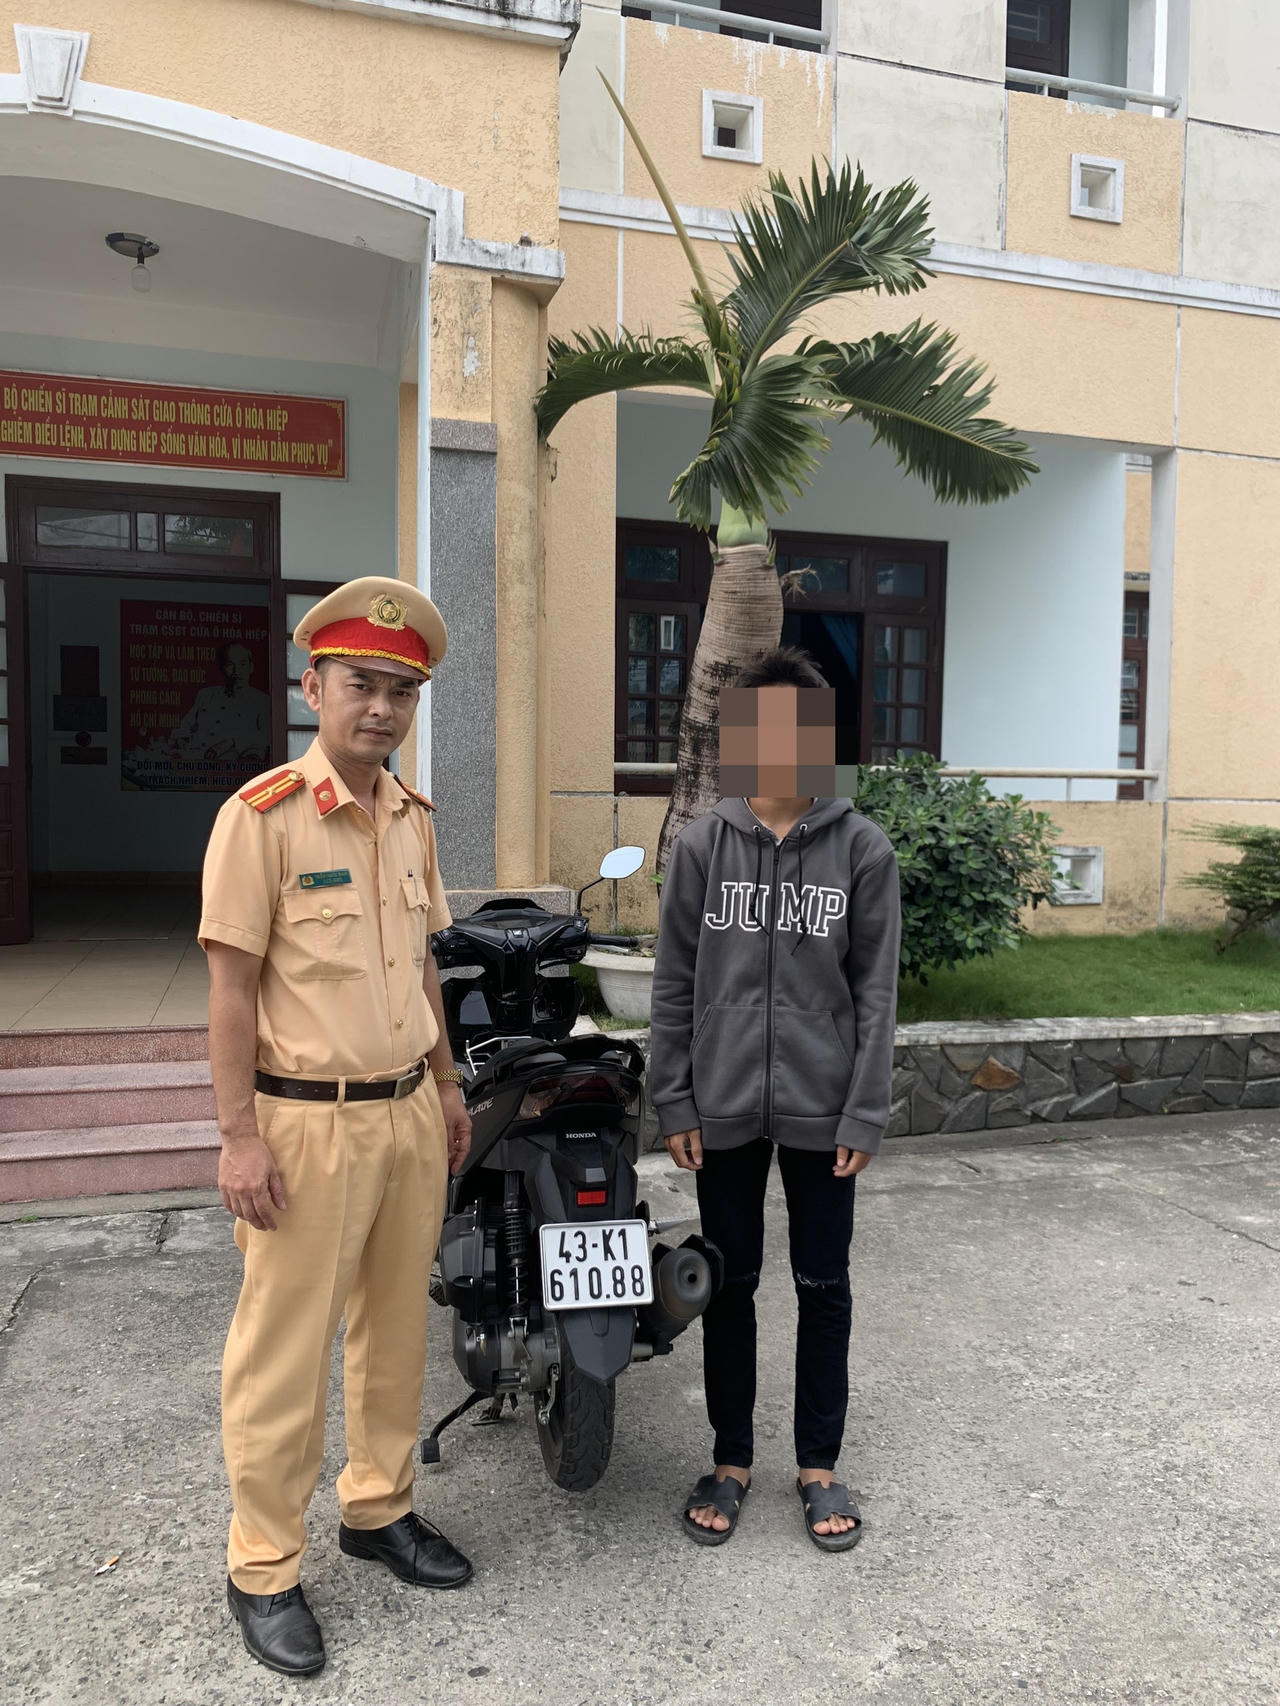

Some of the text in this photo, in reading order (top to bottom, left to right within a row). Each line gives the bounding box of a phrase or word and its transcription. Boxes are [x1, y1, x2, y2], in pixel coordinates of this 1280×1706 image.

[3, 383, 18, 414] BỘ
[21, 383, 53, 413] CHIẾN
[55, 388, 66, 414] SĨ
[69, 392, 98, 421] TRẠM
[100, 389, 128, 419] CẢNH
[131, 394, 150, 421] SÁT
[153, 399, 176, 423] GIAO
[178, 399, 211, 426] THÔNG
[213, 398, 233, 427] CỬA
[266, 405, 288, 435] HIỆP
[0, 416, 32, 444] GHIÊM
[60, 420, 87, 452] LỆNH,
[90, 423, 108, 450] XÂY
[111, 426, 137, 456] DỰNG
[139, 424, 158, 453] NẾP
[160, 425, 186, 455] SỐNG
[188, 431, 207, 457] VĂN
[209, 432, 230, 461] HÓA,
[232, 434, 241, 460] VÌ
[243, 435, 268, 461] NHÂN
[270, 436, 289, 463] DÂN
[291, 442, 315, 469] PHỤC
[161, 625, 187, 638] CSGT
[705, 881, 848, 937] JUMP
[558, 1228, 629, 1263] 43-K1
[550, 1264, 645, 1301] 610.88
